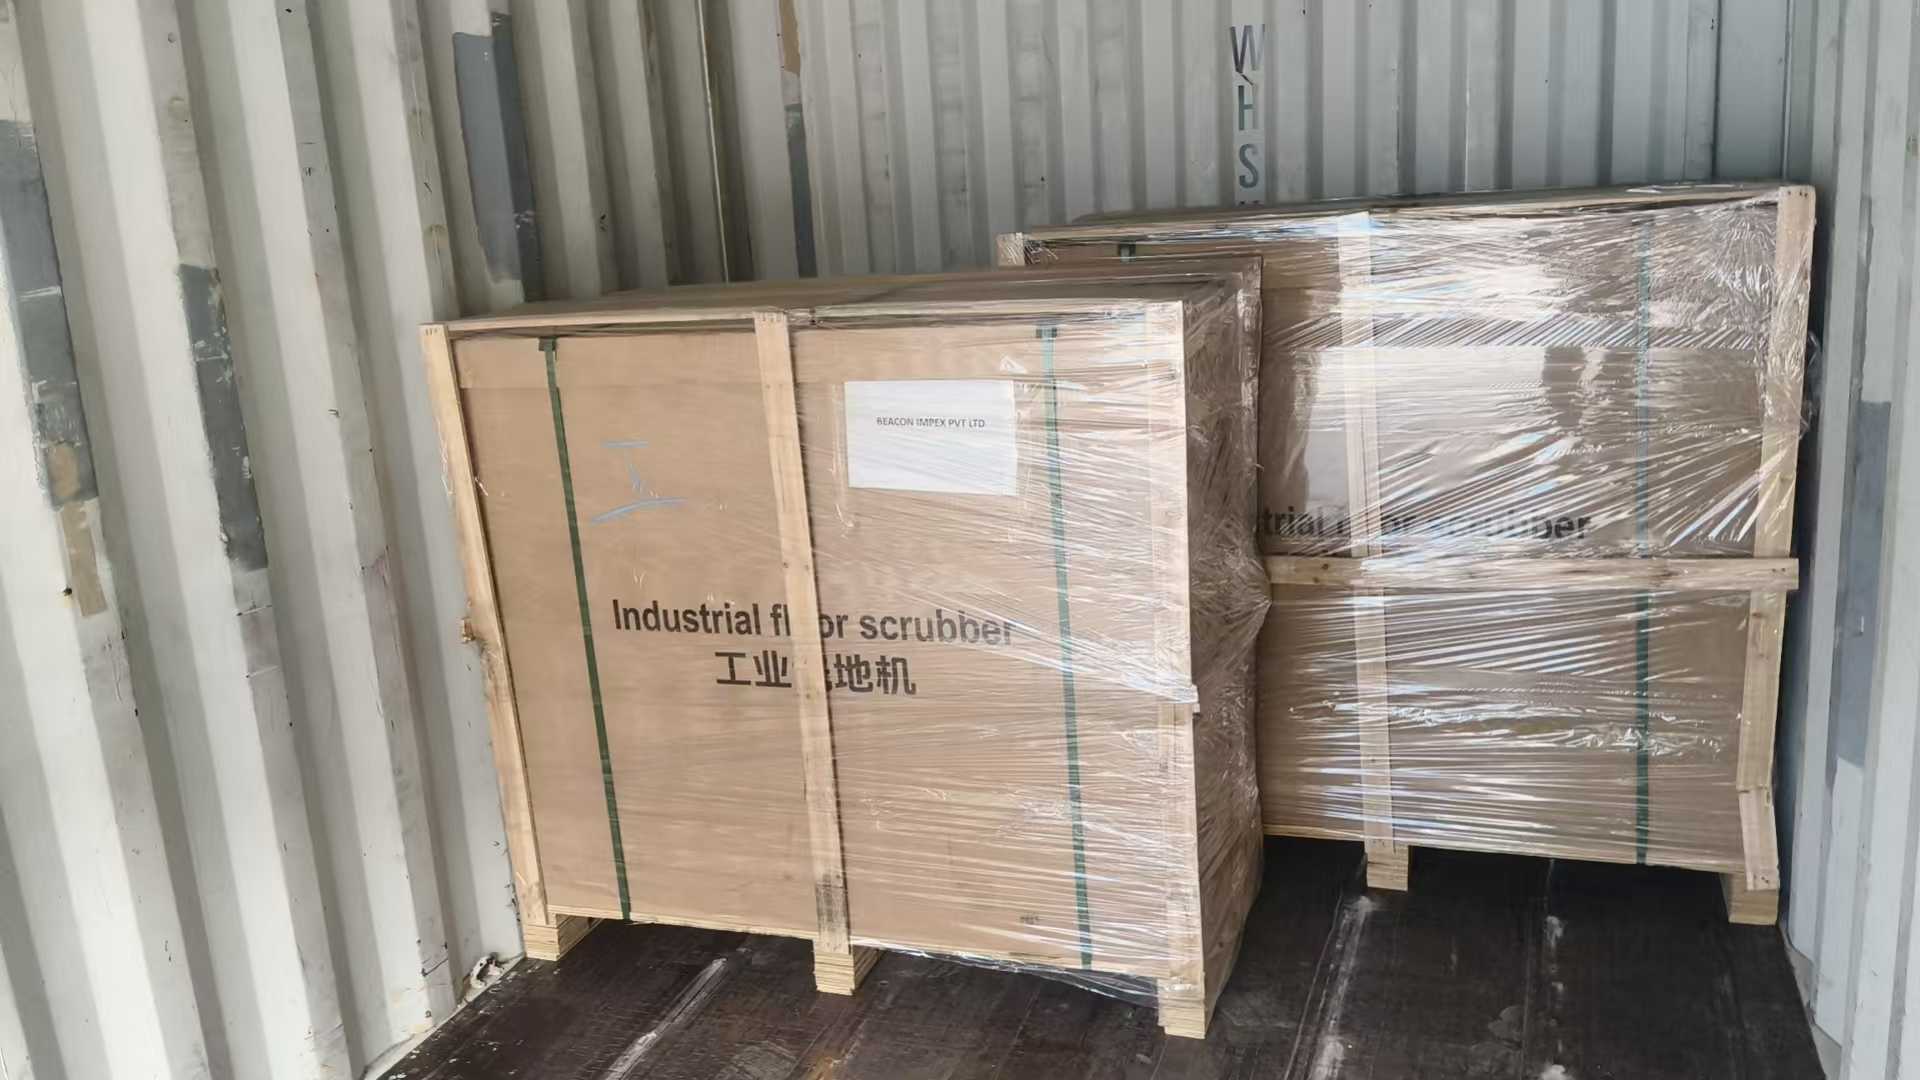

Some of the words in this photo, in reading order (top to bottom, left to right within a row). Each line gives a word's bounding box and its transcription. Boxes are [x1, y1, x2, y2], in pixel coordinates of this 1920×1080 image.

[1229, 23, 1266, 206] WHS
[876, 416, 914, 426] BEACON
[916, 418, 946, 427] IMPEX
[948, 419, 966, 428] PVT
[968, 419, 986, 428] LTD
[1257, 504, 1325, 537] trial
[612, 599, 763, 636] Industrial
[769, 602, 849, 639] flor
[859, 608, 1017, 646] scrubber
